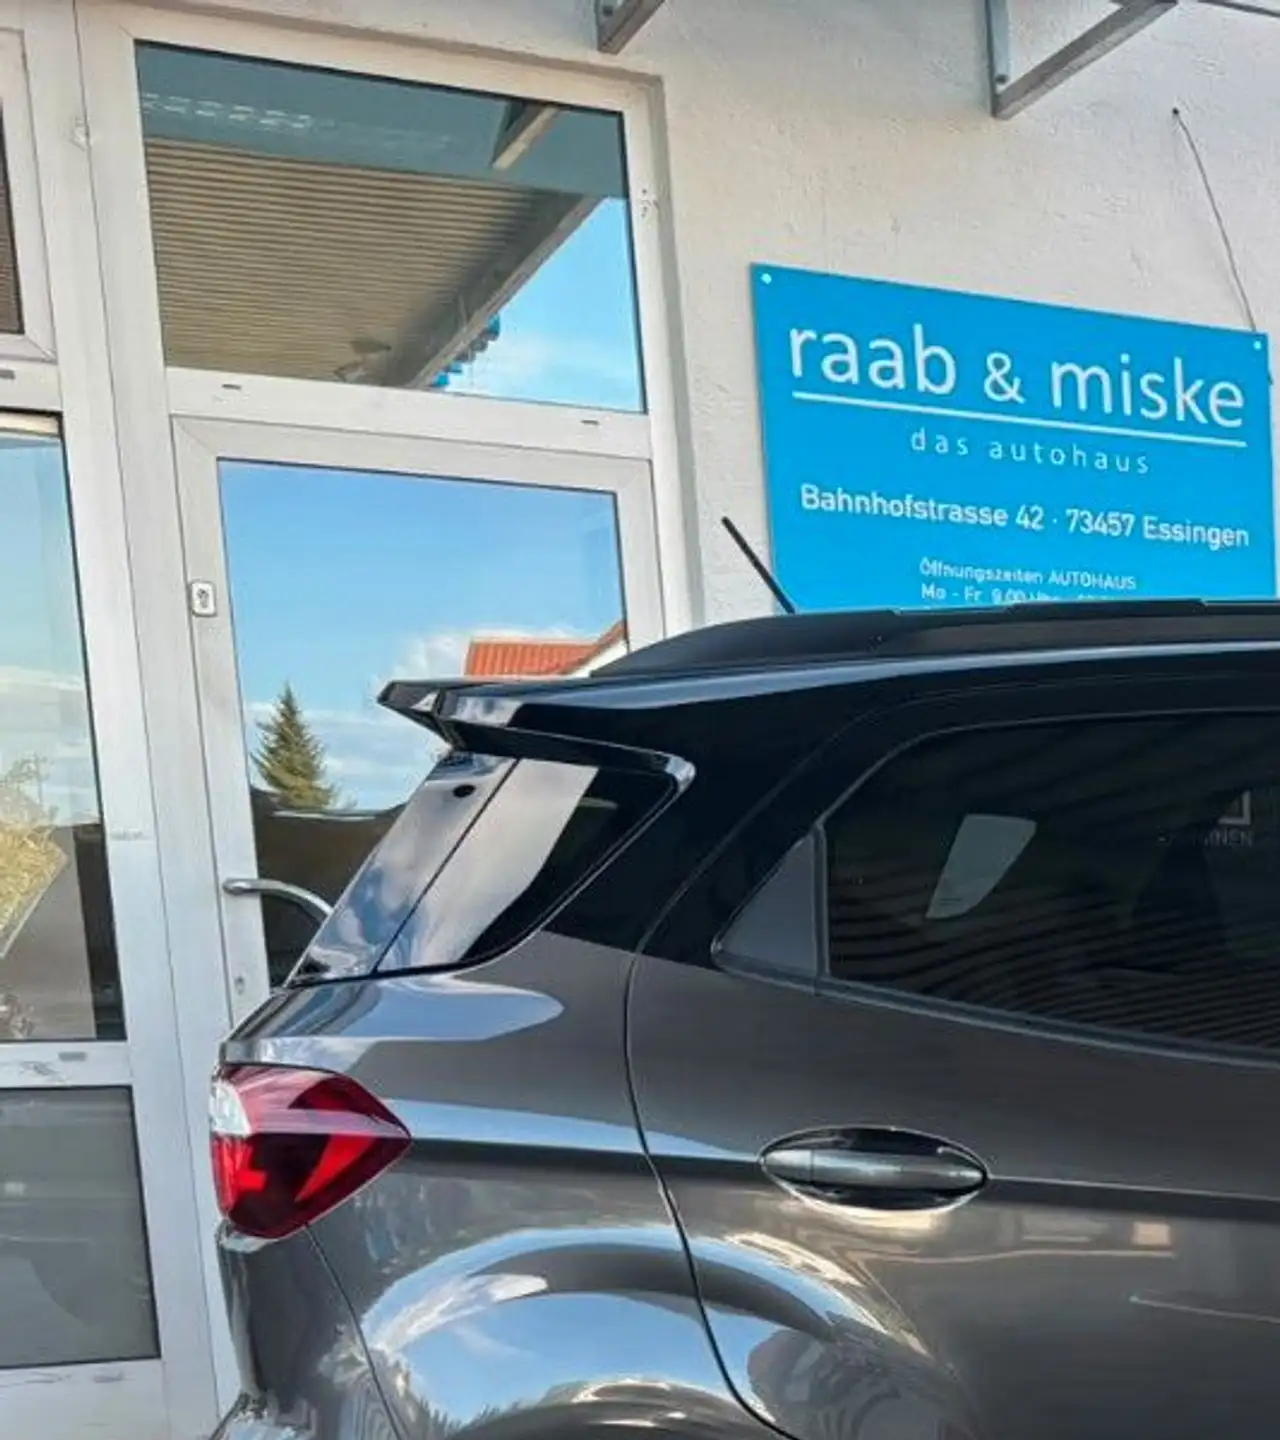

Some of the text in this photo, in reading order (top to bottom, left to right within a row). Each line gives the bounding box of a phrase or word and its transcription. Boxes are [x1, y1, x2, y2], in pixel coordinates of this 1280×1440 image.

[791, 324, 1244, 428] raab & miske
[911, 427, 1149, 474] das autohaus
[800, 483, 1009, 527] Bahnhofstrasse
[1014, 504, 1044, 531] 42
[1065, 507, 1135, 538] 73457
[1141, 514, 1249, 551] Essingen
[920, 583, 947, 600] Mo
[964, 585, 983, 602] Fr
[1047, 570, 1137, 590] AUTOHAUS
